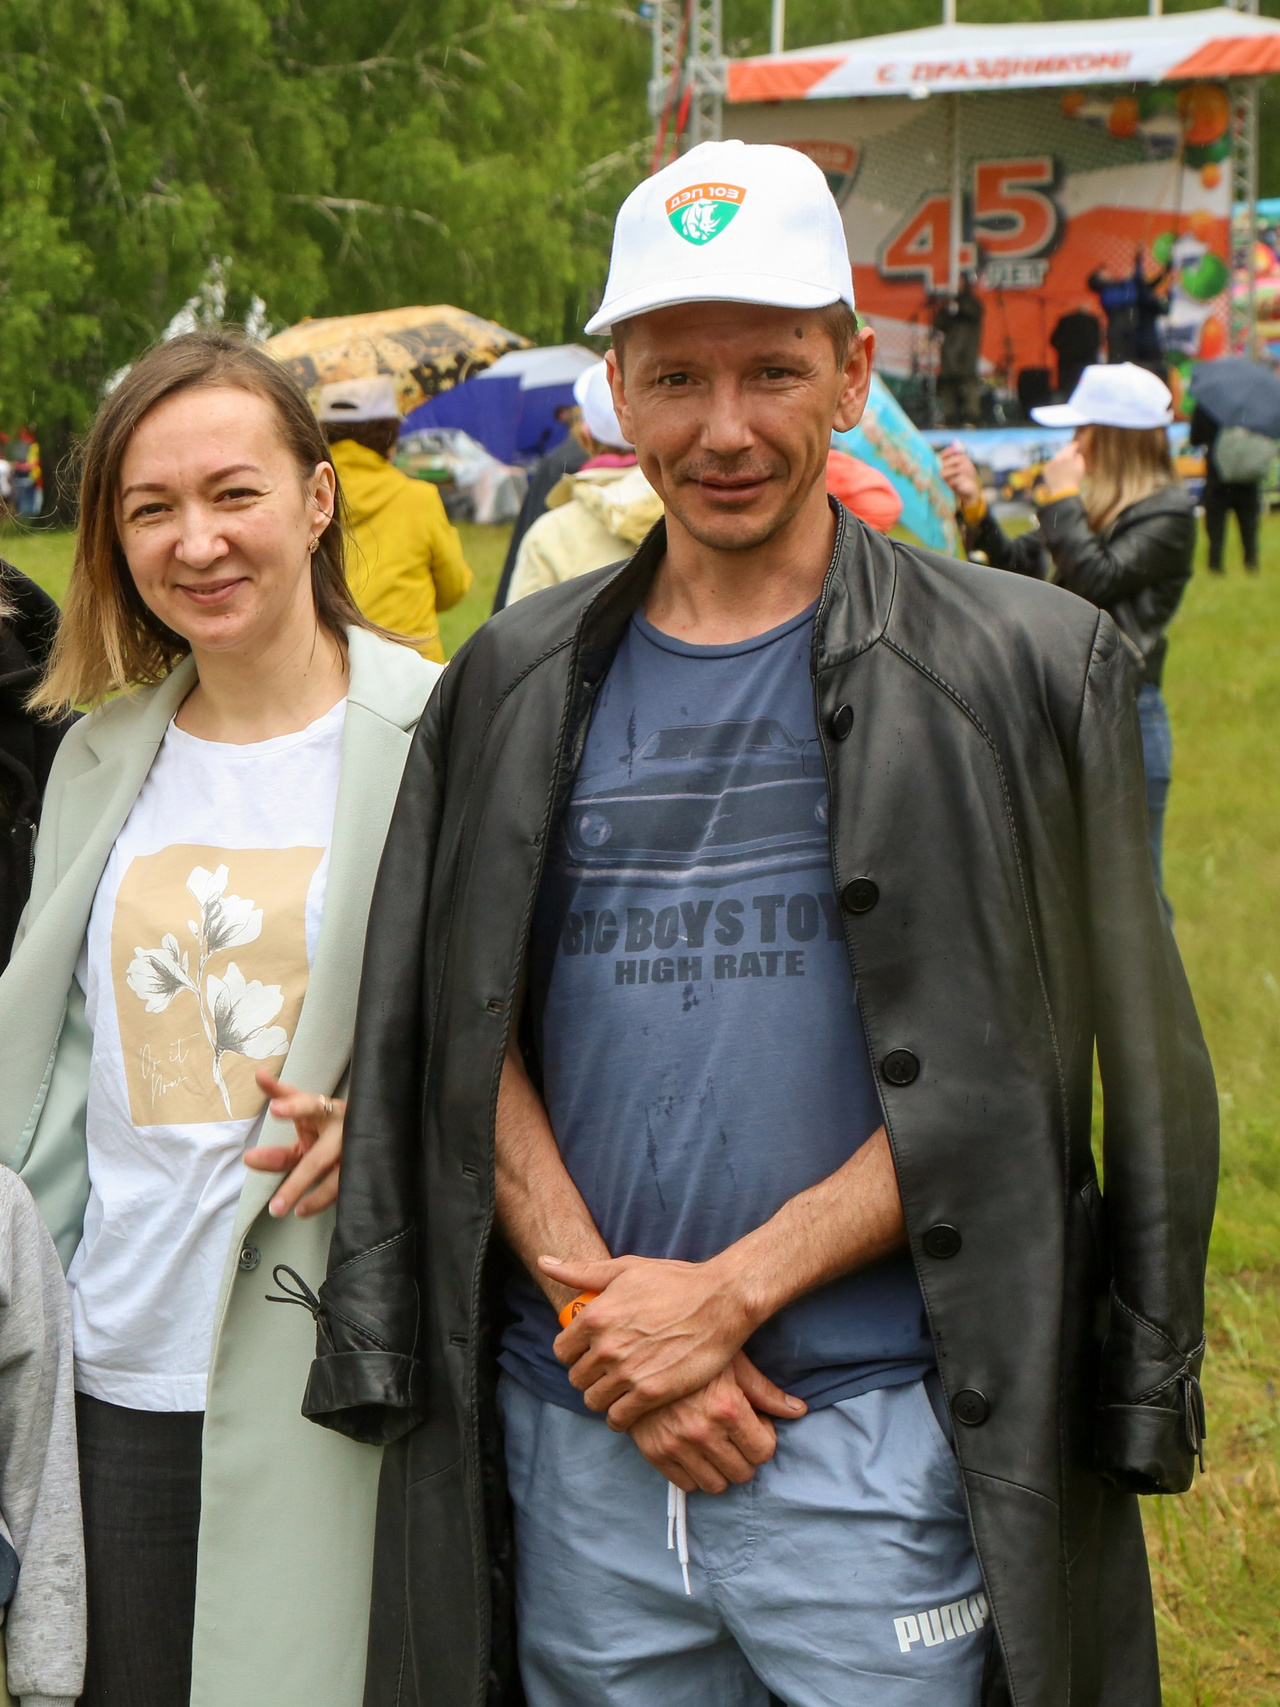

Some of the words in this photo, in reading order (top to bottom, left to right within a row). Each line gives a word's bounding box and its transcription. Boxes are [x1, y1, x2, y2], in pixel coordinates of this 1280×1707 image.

[876, 63, 897, 84] С
[909, 51, 1132, 80] ПРАЗДНИКОМ!
[671, 188, 703, 209] ДЭП
[708, 187, 739, 199] 103
[880, 158, 1058, 292] 45
[562, 909, 618, 955] BIG
[625, 900, 744, 951] BOYS
[615, 957, 702, 984] HIGH
[715, 951, 805, 979] RATE
[169, 1033, 199, 1063] it
[893, 1592, 989, 1653] PUMA
